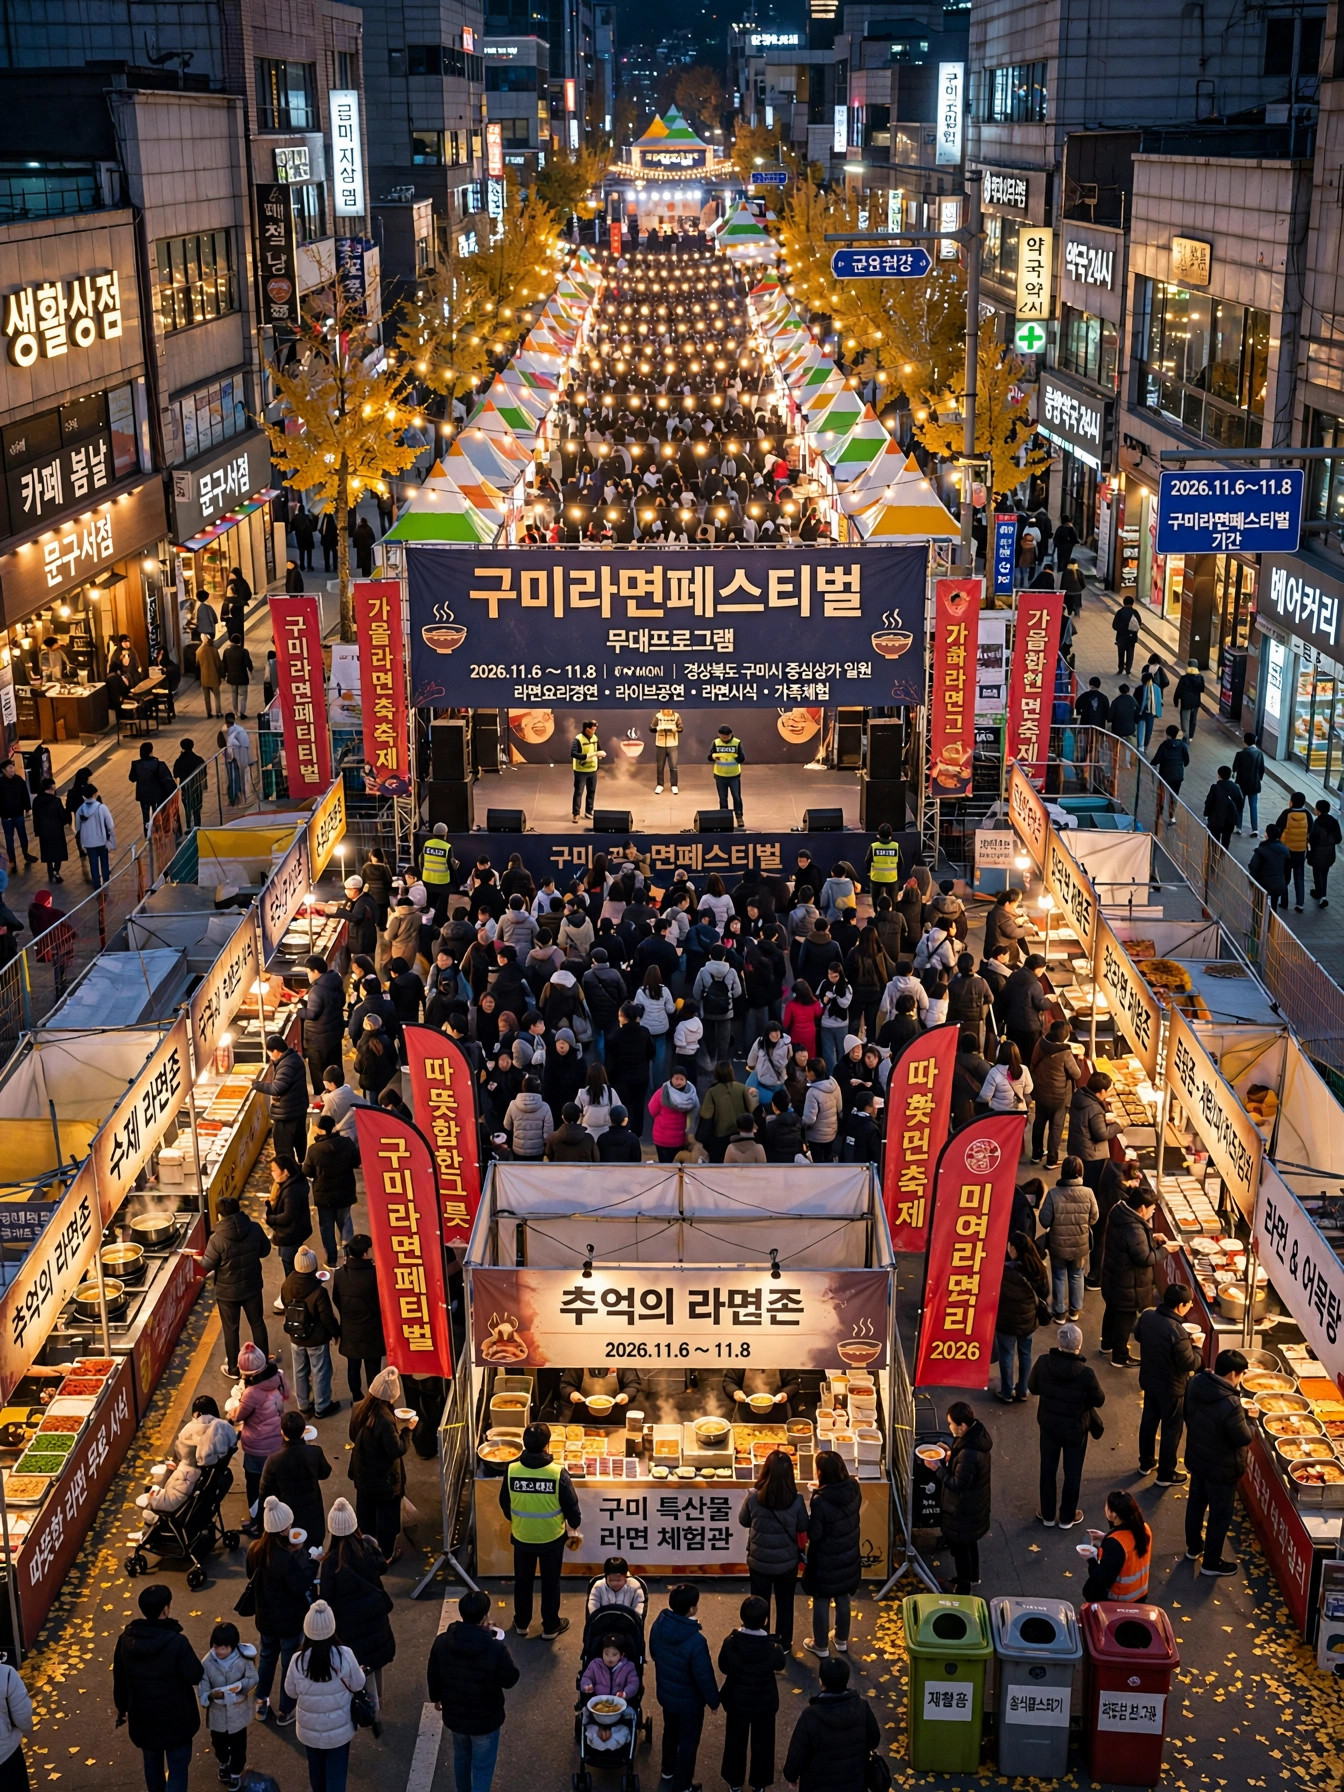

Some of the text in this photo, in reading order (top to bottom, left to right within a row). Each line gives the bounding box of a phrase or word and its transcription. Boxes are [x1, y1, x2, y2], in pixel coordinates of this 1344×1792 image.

[6, 270, 122, 367] 생활상점
[21, 458, 63, 515] 카페
[70, 438, 107, 497] 봄날
[200, 452, 249, 517] 문구서점
[43, 513, 114, 587] 문구서점
[1212, 532, 1242, 550] 기간
[469, 564, 862, 619] 구미라면페스티벌
[1270, 567, 1338, 645] 베어커리
[606, 628, 734, 654] 무대프로그램
[470, 664, 542, 679] 2026.11.6
[565, 664, 597, 679] 11.8
[684, 662, 739, 680] 경상북도
[741, 662, 782, 679] 구미시
[785, 662, 842, 680] 중심상가
[844, 662, 872, 679] 일원
[514, 683, 830, 701] 라면요리경연 라이브공연 라면시식 가족체험
[110, 1105, 141, 1181] 수제
[378, 1137, 434, 1352] 구미라면페티벌
[12, 1259, 54, 1349] 추억의
[559, 1286, 805, 1326] 추억의 라면존
[605, 1342, 690, 1358] 2026.11.6
[715, 1342, 751, 1358] 11.8
[930, 1340, 980, 1360] 2026
[599, 1496, 732, 1521] 구미 특산물
[600, 1526, 734, 1551] 라면 체험관
